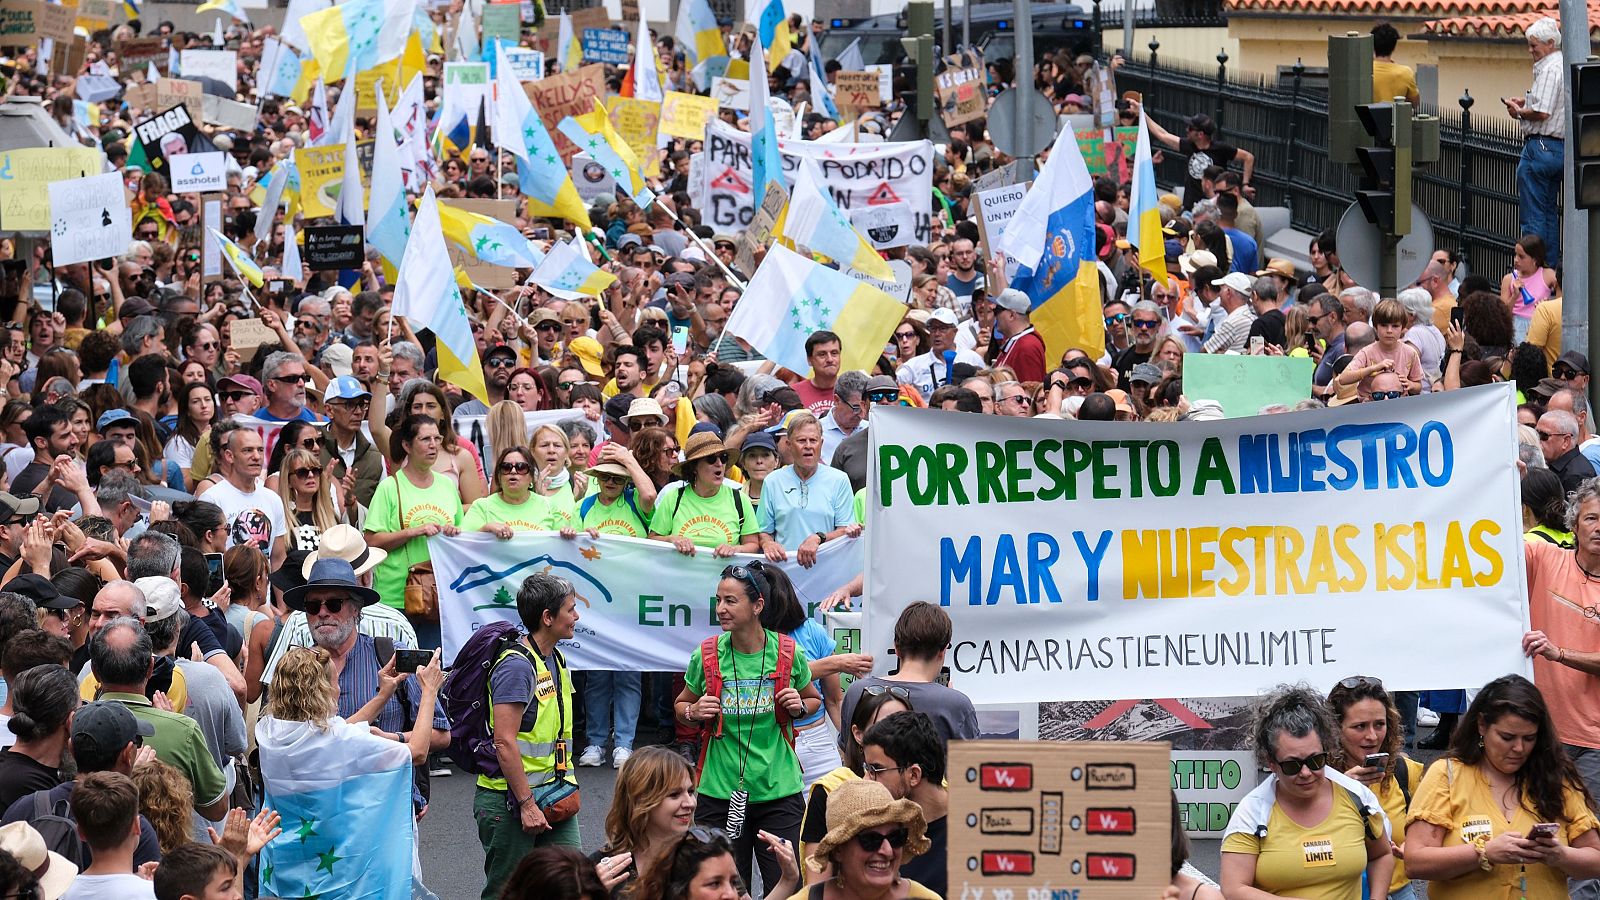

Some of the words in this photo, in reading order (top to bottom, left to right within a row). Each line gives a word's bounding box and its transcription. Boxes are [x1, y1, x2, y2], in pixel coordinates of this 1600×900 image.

[533, 78, 597, 109] KELLYS
[851, 92, 870, 103] YA
[137, 106, 190, 145] FRAGA
[824, 154, 926, 180] PODRIDO
[177, 175, 221, 186] asshotel
[984, 191, 1023, 208] QUIERO
[987, 213, 1002, 223] UN
[809, 400, 836, 411] UIKSIL
[879, 443, 970, 507] POR
[975, 438, 1181, 503] RESPETO
[1192, 436, 1237, 496] A
[1238, 420, 1454, 495] NUESTRO
[940, 532, 1063, 607] MAR
[1072, 529, 1114, 602] Y
[1121, 522, 1368, 600] NUESTRAS
[1374, 518, 1504, 592] ISLAS
[638, 594, 692, 627] En
[1303, 840, 1331, 848] CANARIAS
